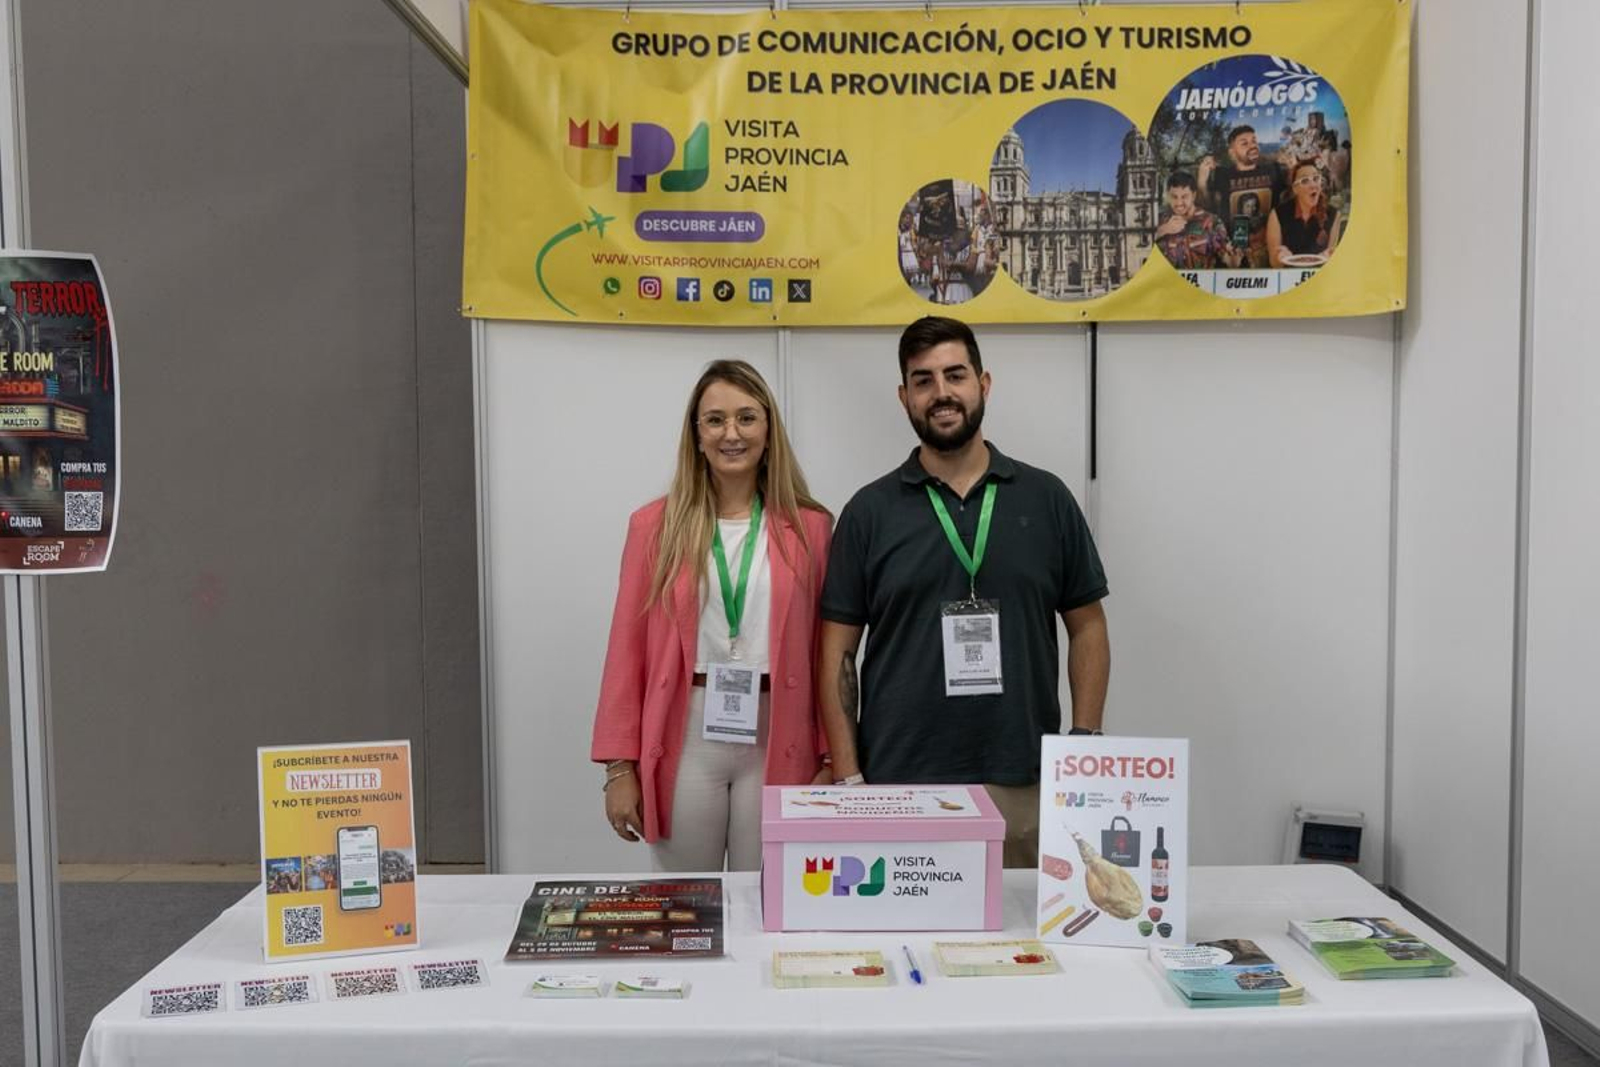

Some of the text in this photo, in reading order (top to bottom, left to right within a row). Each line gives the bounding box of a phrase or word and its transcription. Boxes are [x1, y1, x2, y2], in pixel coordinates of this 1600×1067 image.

[611, 22, 1252, 57] GRUPO DE COMUNICACIÓN, OCIO Y TURISMO
[747, 66, 1117, 95] DE LA PROVINCIA DE JAÉN
[1175, 80, 1319, 111] JAENÓLOGOS
[724, 120, 800, 138] VISITA
[724, 147, 849, 167] PROVINCIA
[724, 171, 788, 193] JAÉN
[642, 216, 756, 233] DESCUBRE JÁEN
[591, 252, 821, 270] WWW.VISITARPROVINCIAJAEN.COM
[1226, 277, 1269, 290] GUELMI
[11, 280, 100, 318] TERROR
[13, 351, 54, 372] ROOM
[60, 462, 107, 474] COMPRA TUS
[9, 516, 43, 528] CANENA
[26, 544, 61, 553] ESCAPE
[26, 552, 61, 562] ROOM
[272, 751, 399, 768] ¡SUBCRÍBETE A NUESTRA
[1055, 754, 1175, 781] ¡SORTEO!
[289, 771, 379, 791] NEWSLETTER
[272, 791, 403, 808] Y NO TE PIERDAS NINGÚN
[316, 808, 362, 820] EVENTO!
[893, 856, 936, 866] VISITA
[893, 871, 963, 882] PROVINCIA
[537, 886, 587, 896] CINE
[593, 886, 632, 895] DEL
[893, 885, 929, 897] JAÉN
